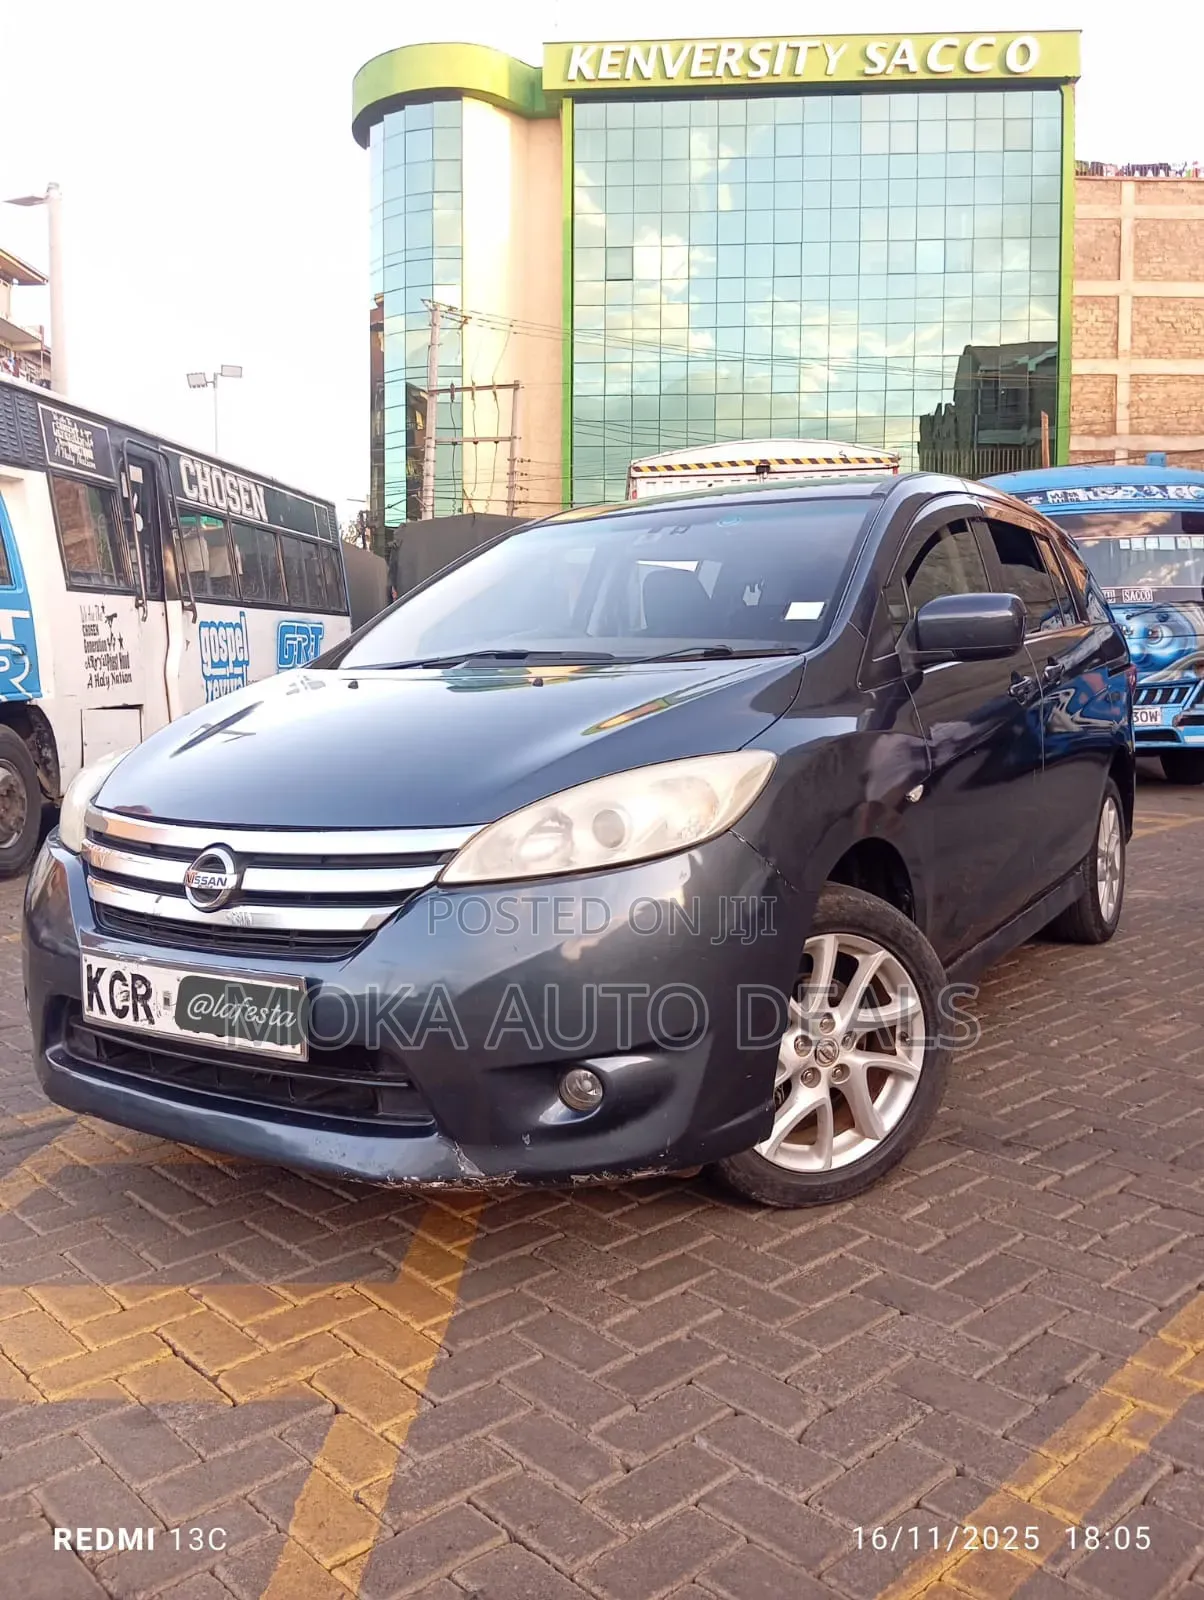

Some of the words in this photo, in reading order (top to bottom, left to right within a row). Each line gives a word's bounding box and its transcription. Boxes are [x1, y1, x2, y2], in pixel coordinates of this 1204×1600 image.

[566, 38, 848, 82] KENVERSITY
[862, 34, 1041, 79] SACCO
[179, 455, 269, 523] CHOSEN
[1124, 590, 1152, 602] SACCO
[200, 611, 249, 677] gospel
[186, 871, 228, 887] NISSAN
[86, 963, 156, 1026] KCR
